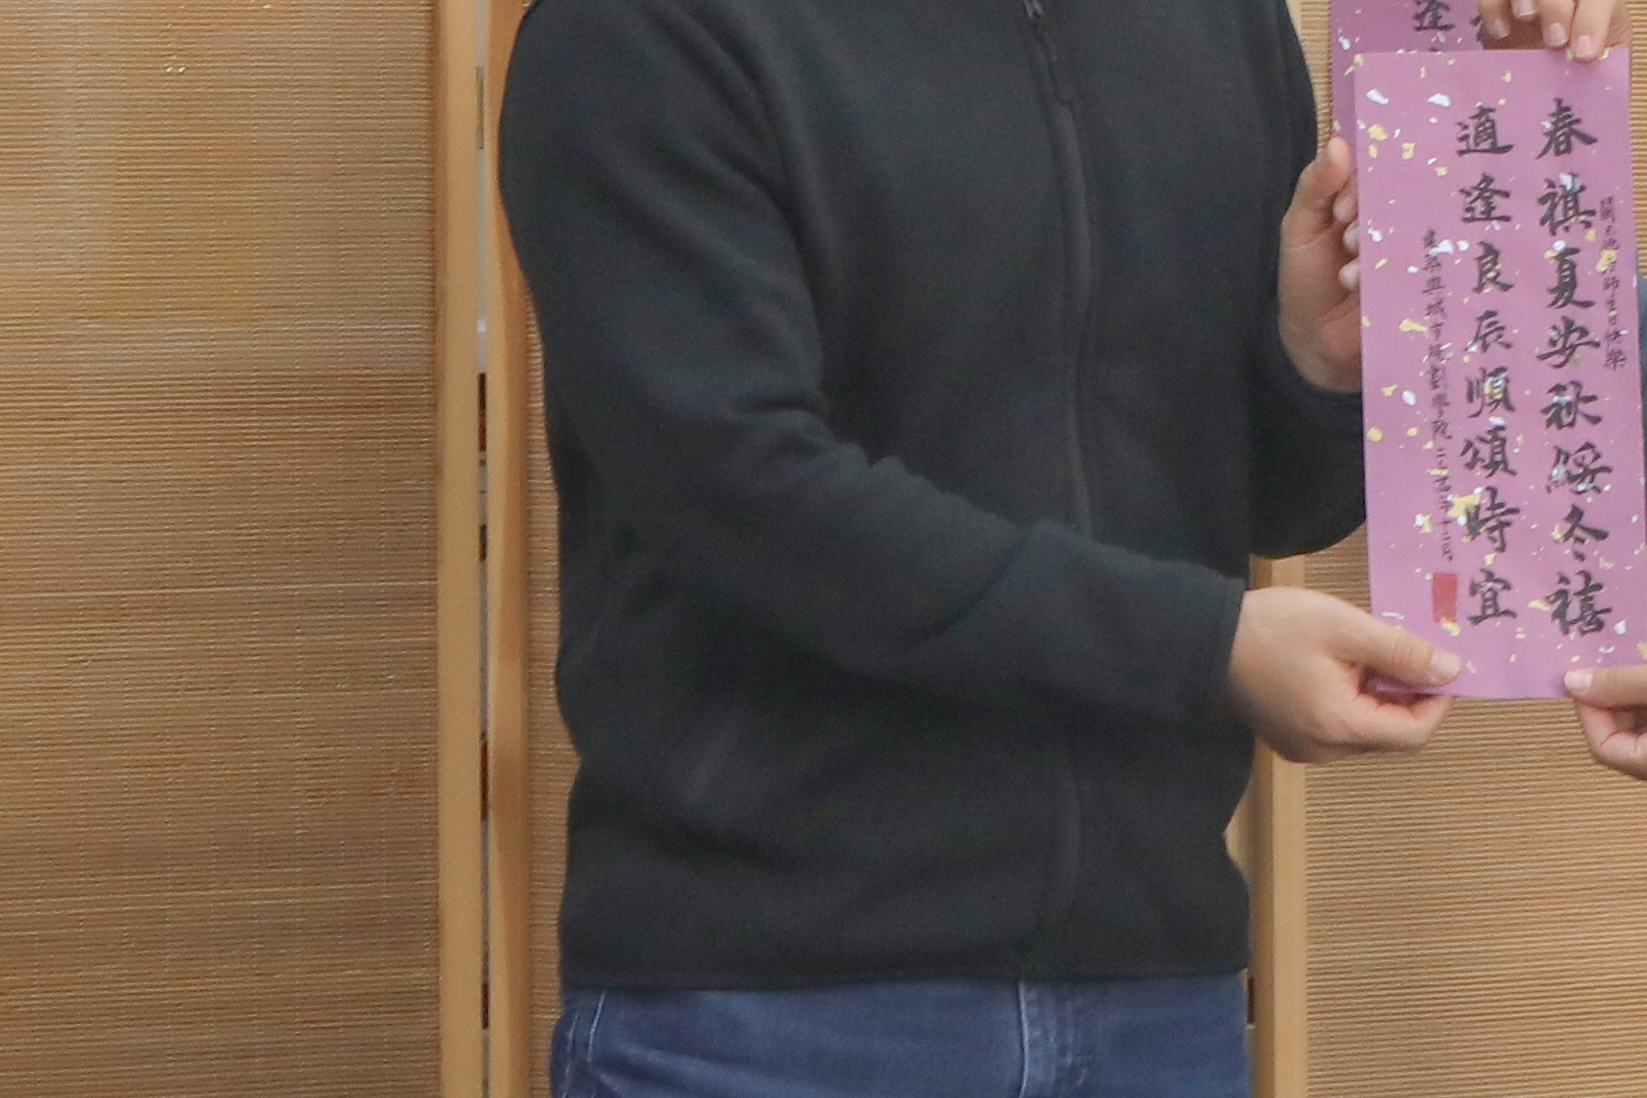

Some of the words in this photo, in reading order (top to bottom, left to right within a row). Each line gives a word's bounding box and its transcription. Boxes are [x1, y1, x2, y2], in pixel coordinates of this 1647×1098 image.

[1456, 105, 1520, 625] 適逢良辰順頌時宜
[1536, 97, 1613, 636] 春祺夏安秋綏冬禧
